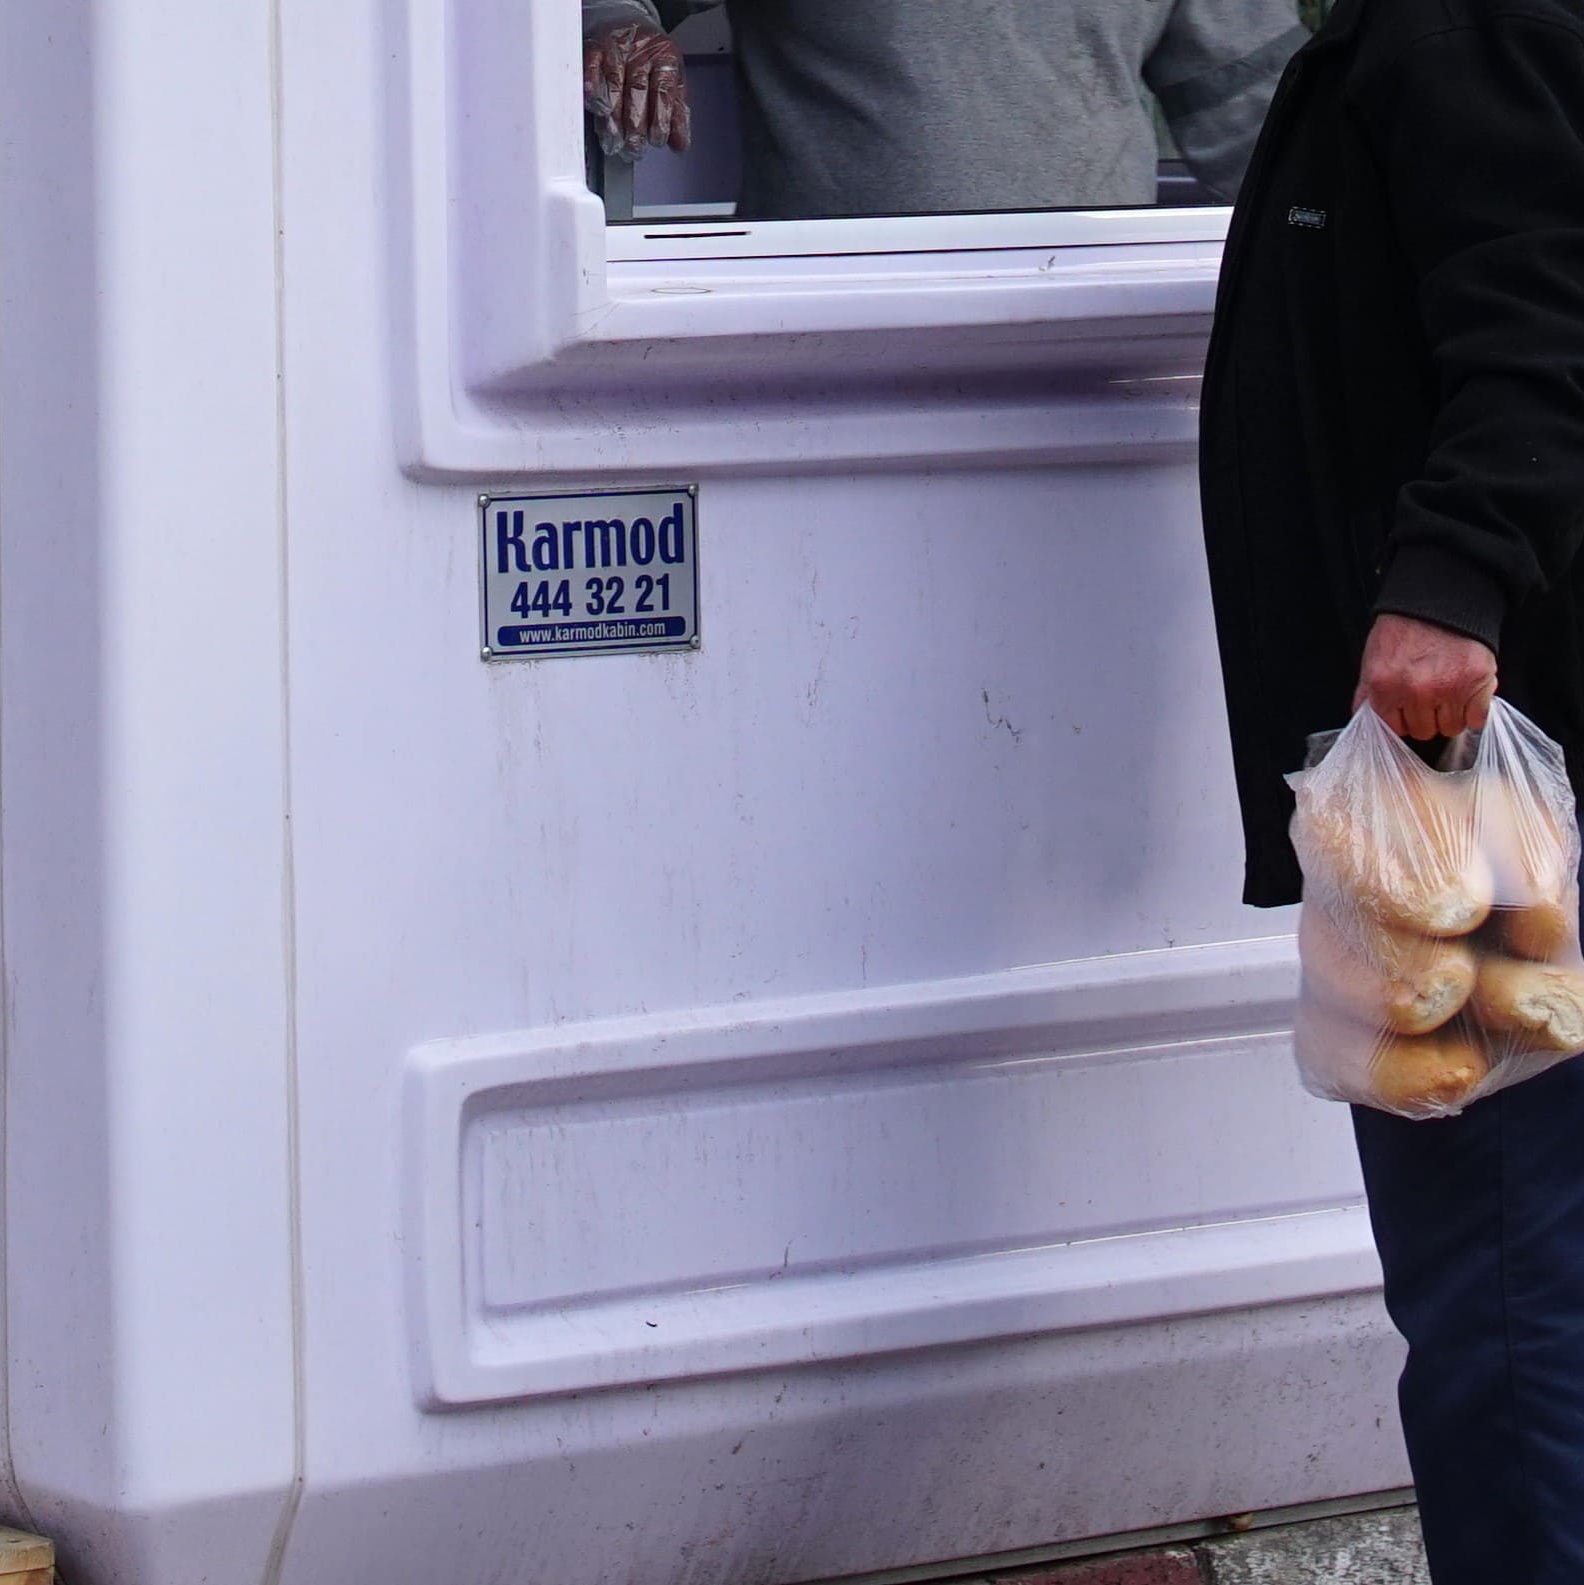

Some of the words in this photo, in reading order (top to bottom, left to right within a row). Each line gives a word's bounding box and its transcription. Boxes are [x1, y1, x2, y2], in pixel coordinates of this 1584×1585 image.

[496, 502, 685, 574] Karmod
[510, 579, 573, 619] 444
[585, 576, 625, 616] 32
[635, 573, 671, 613] 21
[519, 621, 666, 644] www.karmodkabin.com
